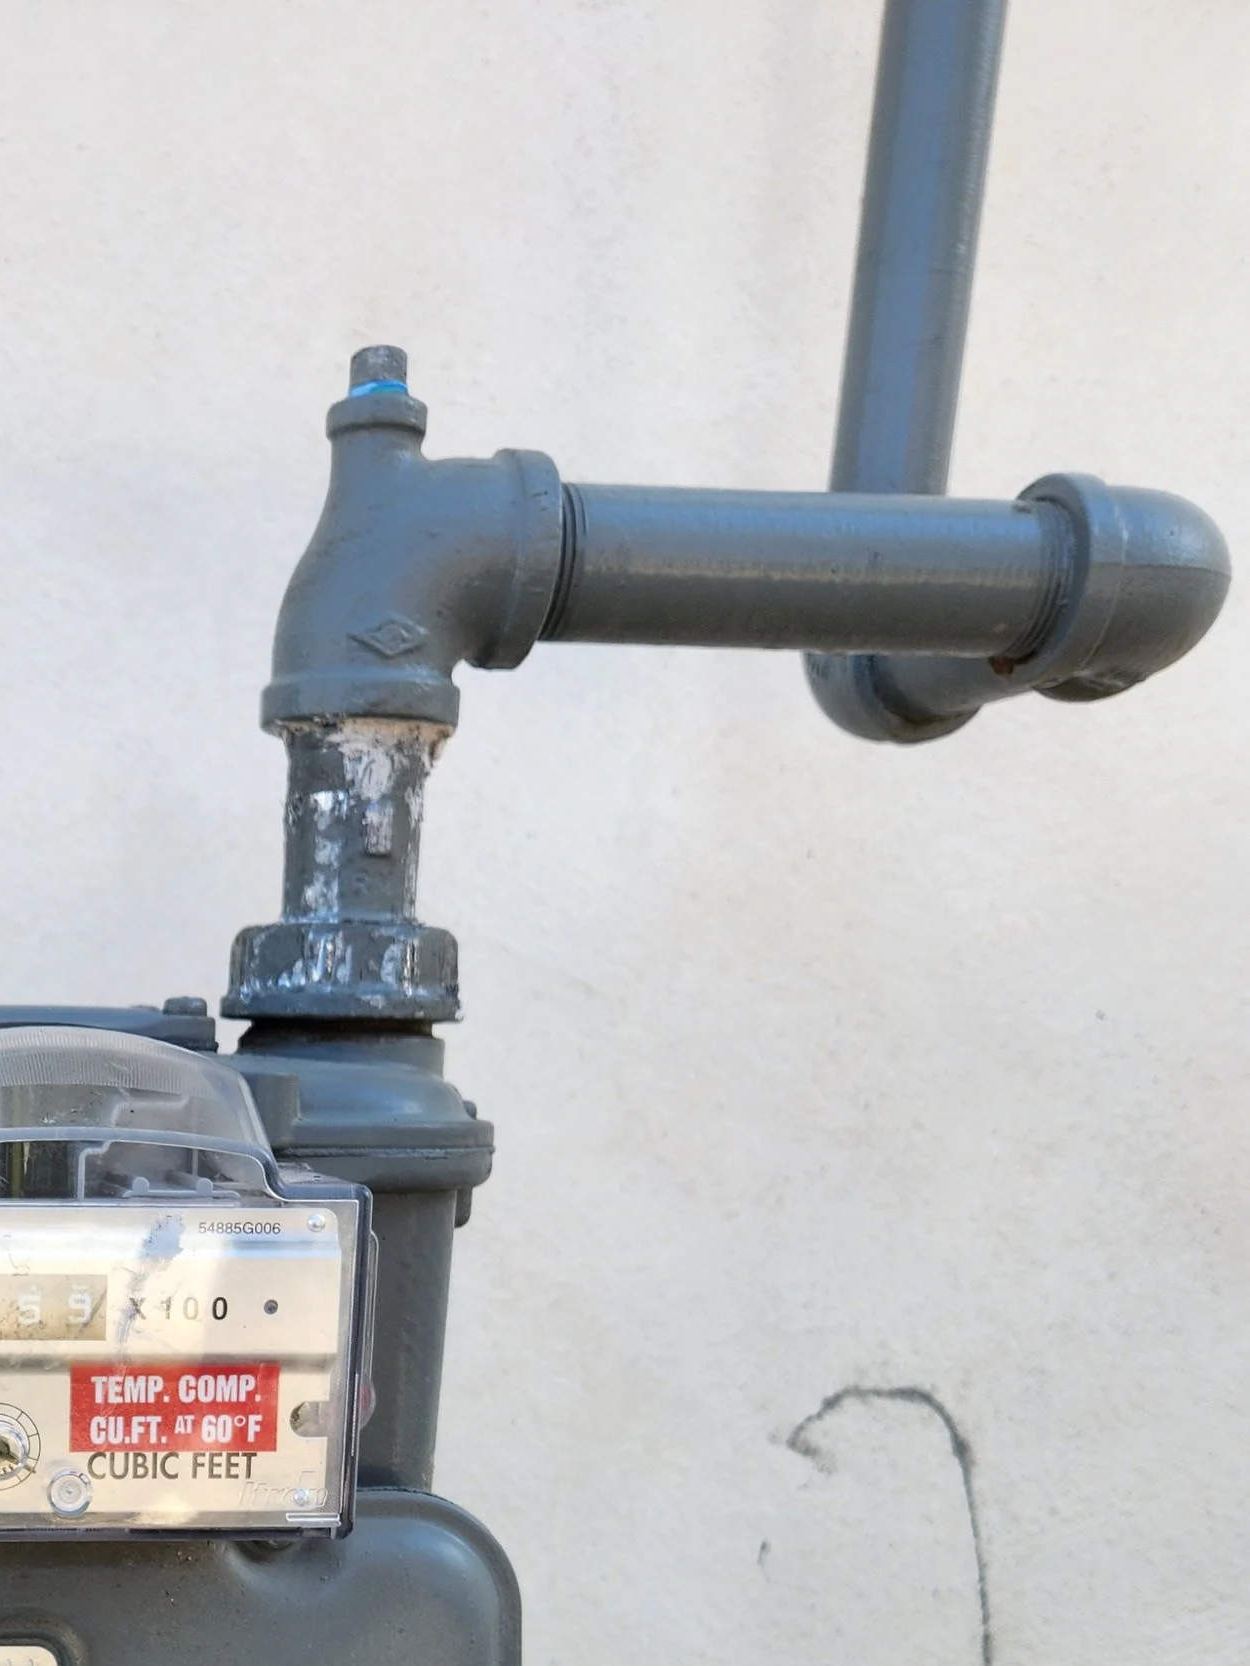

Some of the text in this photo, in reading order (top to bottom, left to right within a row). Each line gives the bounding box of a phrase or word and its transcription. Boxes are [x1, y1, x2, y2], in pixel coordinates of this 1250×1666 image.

[198, 1221, 281, 1236] 54885G006
[90, 1374, 262, 1404] TEMP. COMP.
[89, 1415, 168, 1445] CU.FT.
[174, 1415, 195, 1434] AT
[86, 1451, 258, 1480] CUBIC FEET
